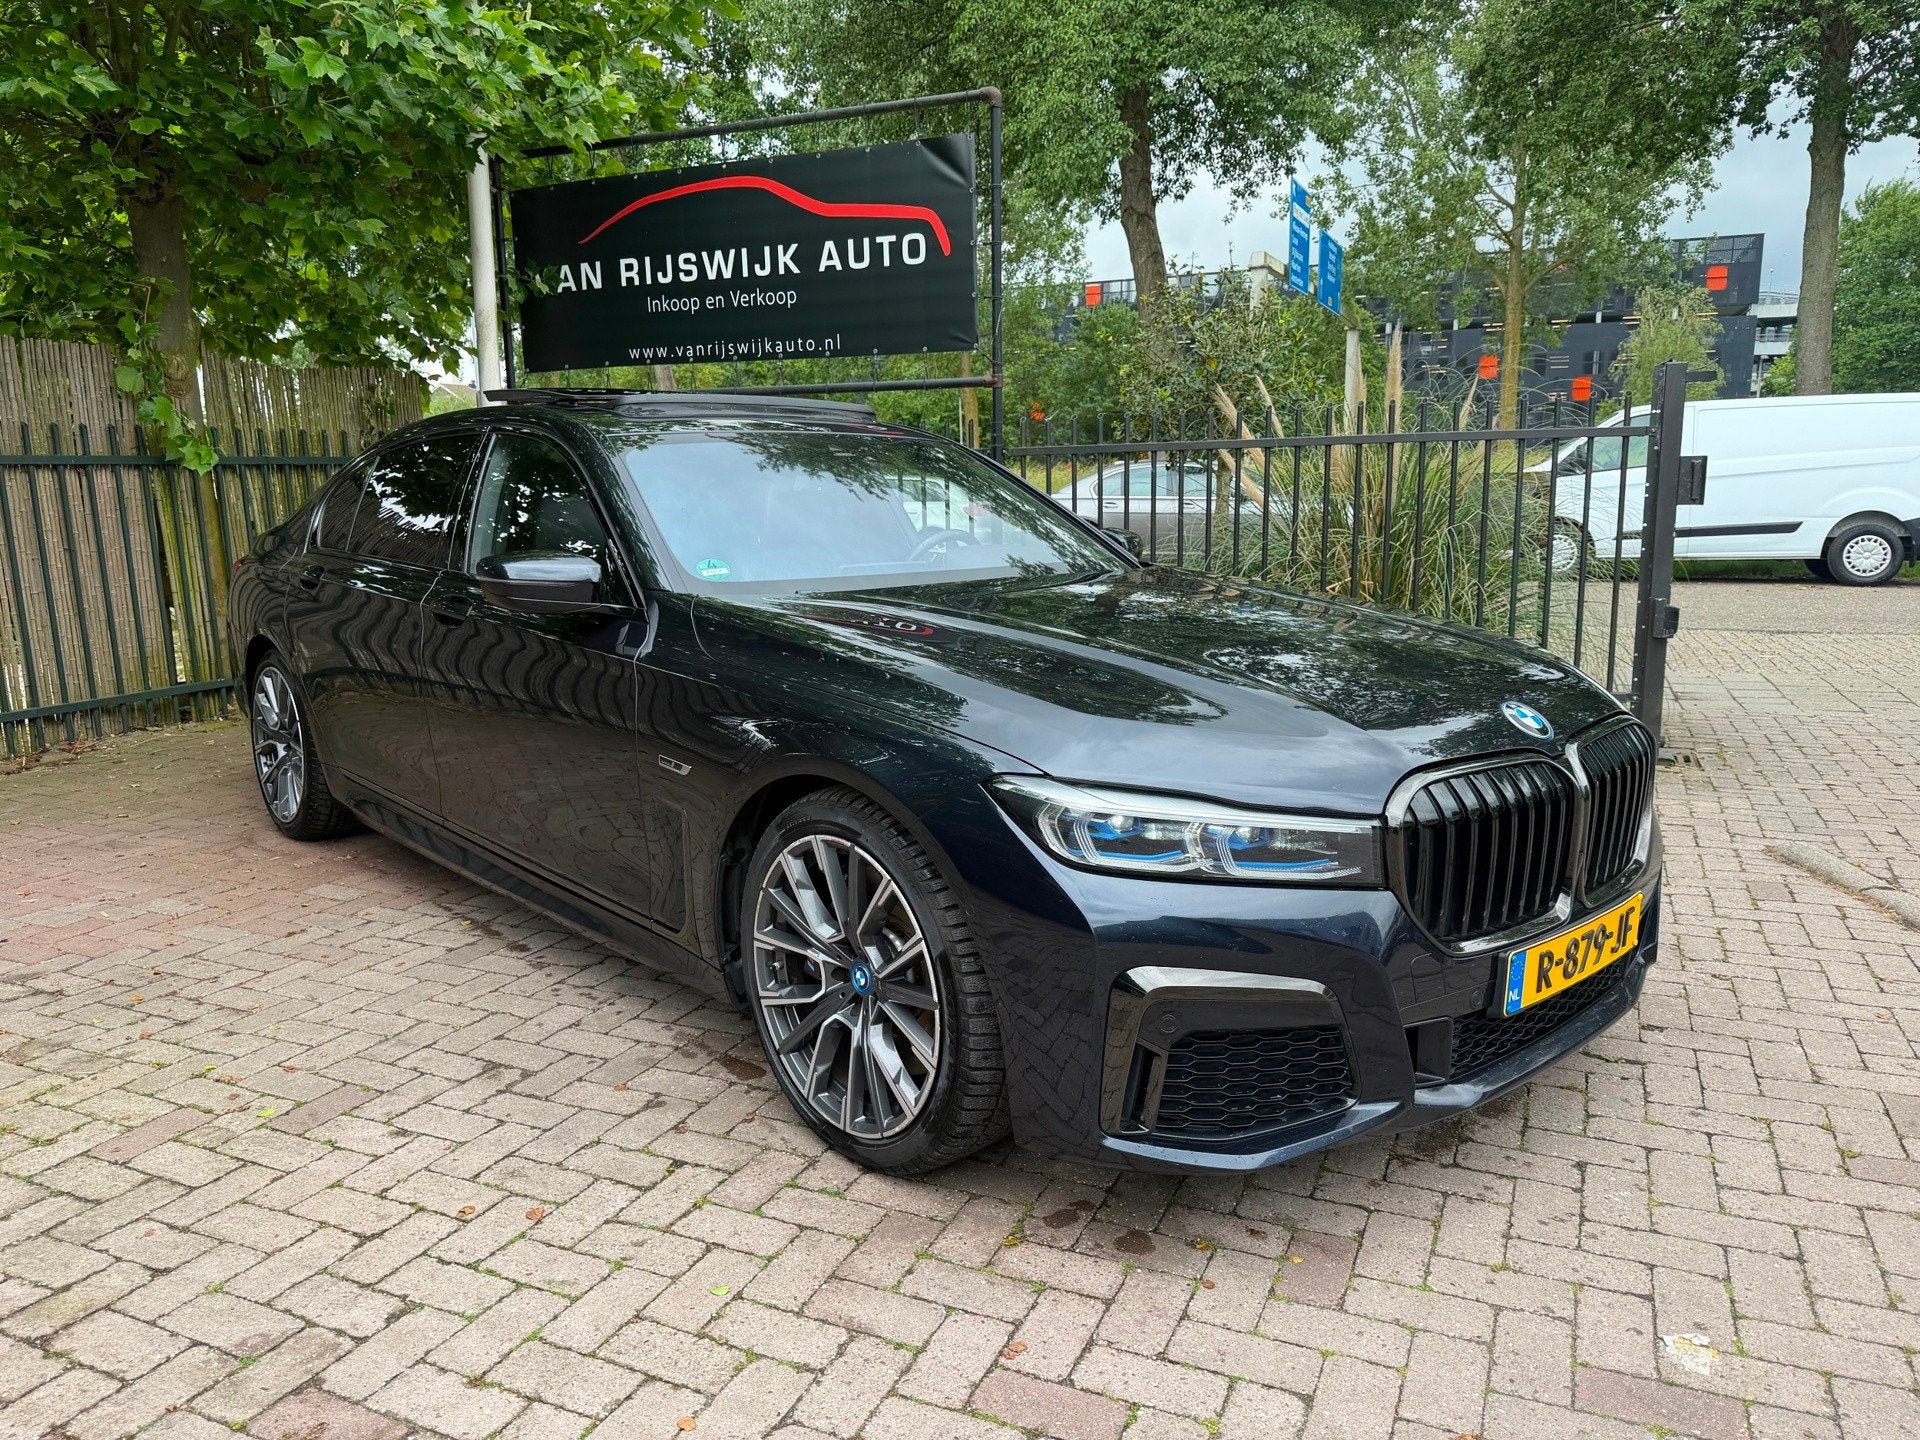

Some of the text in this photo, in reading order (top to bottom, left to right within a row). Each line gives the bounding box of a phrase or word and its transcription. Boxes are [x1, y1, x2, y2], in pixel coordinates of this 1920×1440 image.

[534, 232, 927, 294] AN RIJSWIJK AUTO
[647, 288, 798, 314] Inkoop en Verkoop
[629, 334, 841, 360] www.vanrijswijkauto.nl
[1536, 906, 1636, 993] R-879-JF
[1508, 989, 1520, 1002] NL
